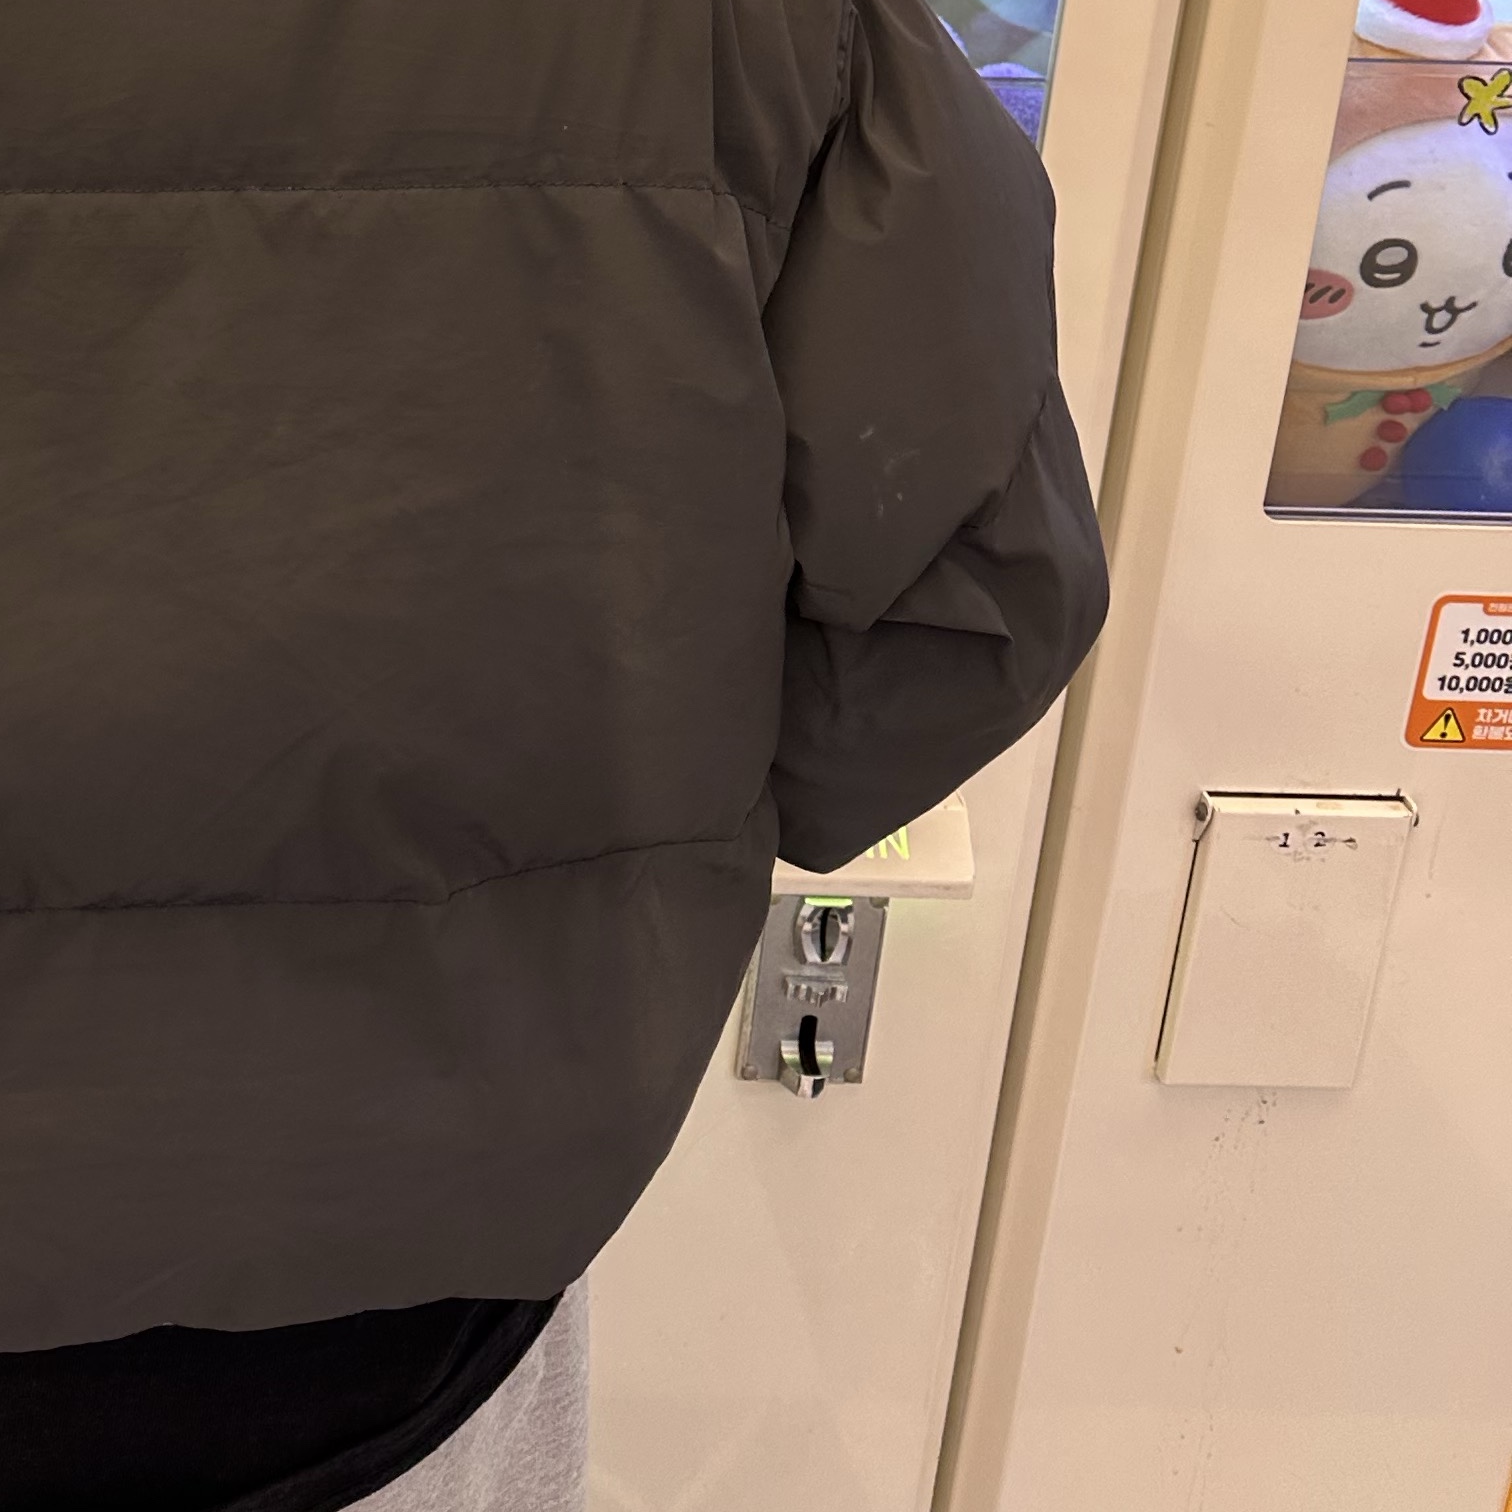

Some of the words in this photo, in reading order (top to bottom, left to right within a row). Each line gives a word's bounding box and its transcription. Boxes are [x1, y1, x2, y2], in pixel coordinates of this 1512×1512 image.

[1453, 651, 1512, 670] 5,000
[1475, 708, 1512, 724] 차거
[1278, 831, 1290, 848] 1
[1313, 831, 1327, 848] 2
